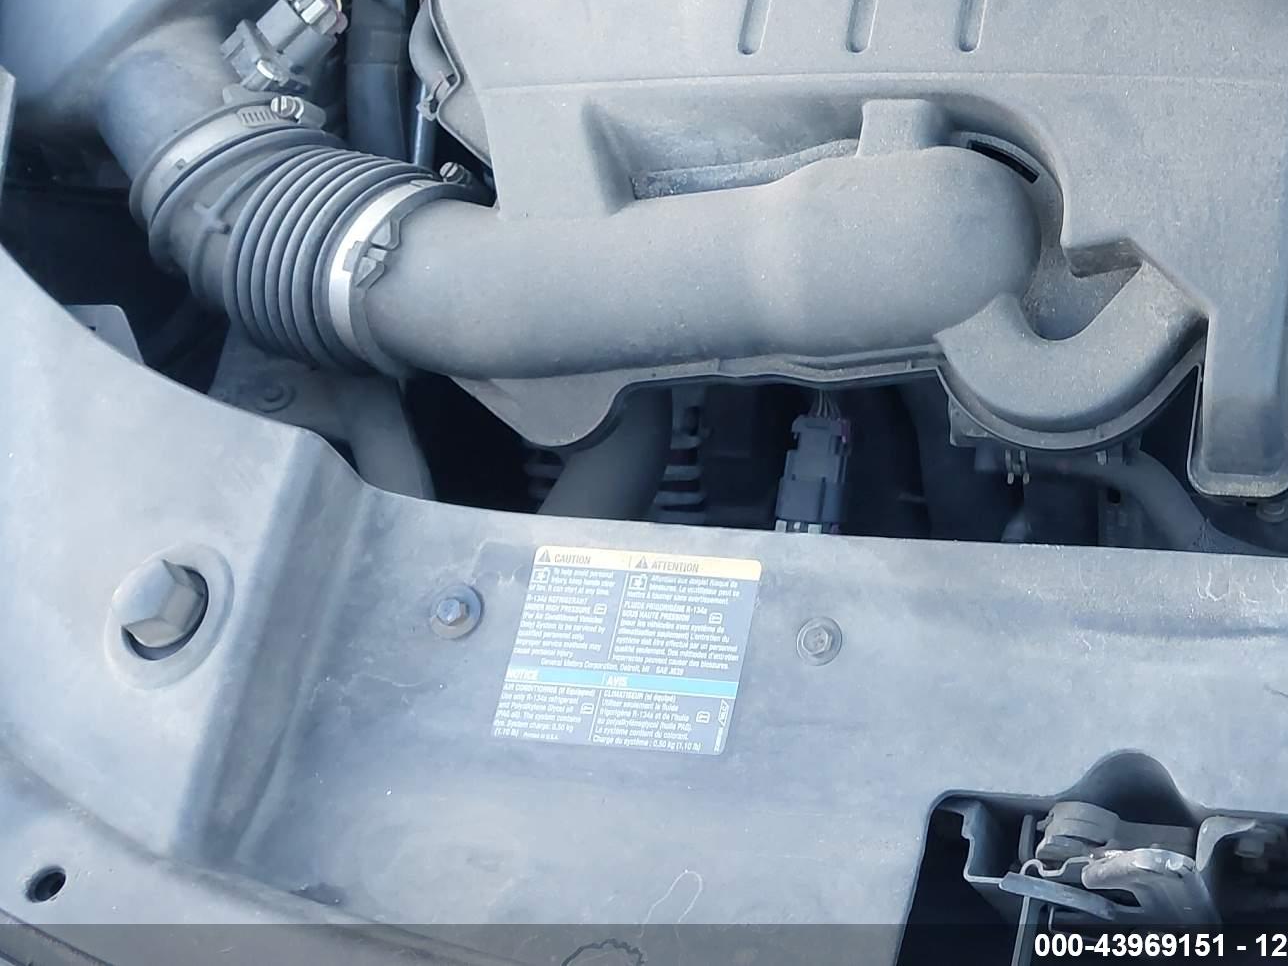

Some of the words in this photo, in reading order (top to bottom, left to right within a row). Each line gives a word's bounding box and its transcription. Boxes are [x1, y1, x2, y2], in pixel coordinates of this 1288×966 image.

[555, 554, 591, 564] CAUTION
[652, 561, 699, 572] ATTENTION
[507, 670, 538, 679] NOTICE
[608, 677, 628, 686] AVIS
